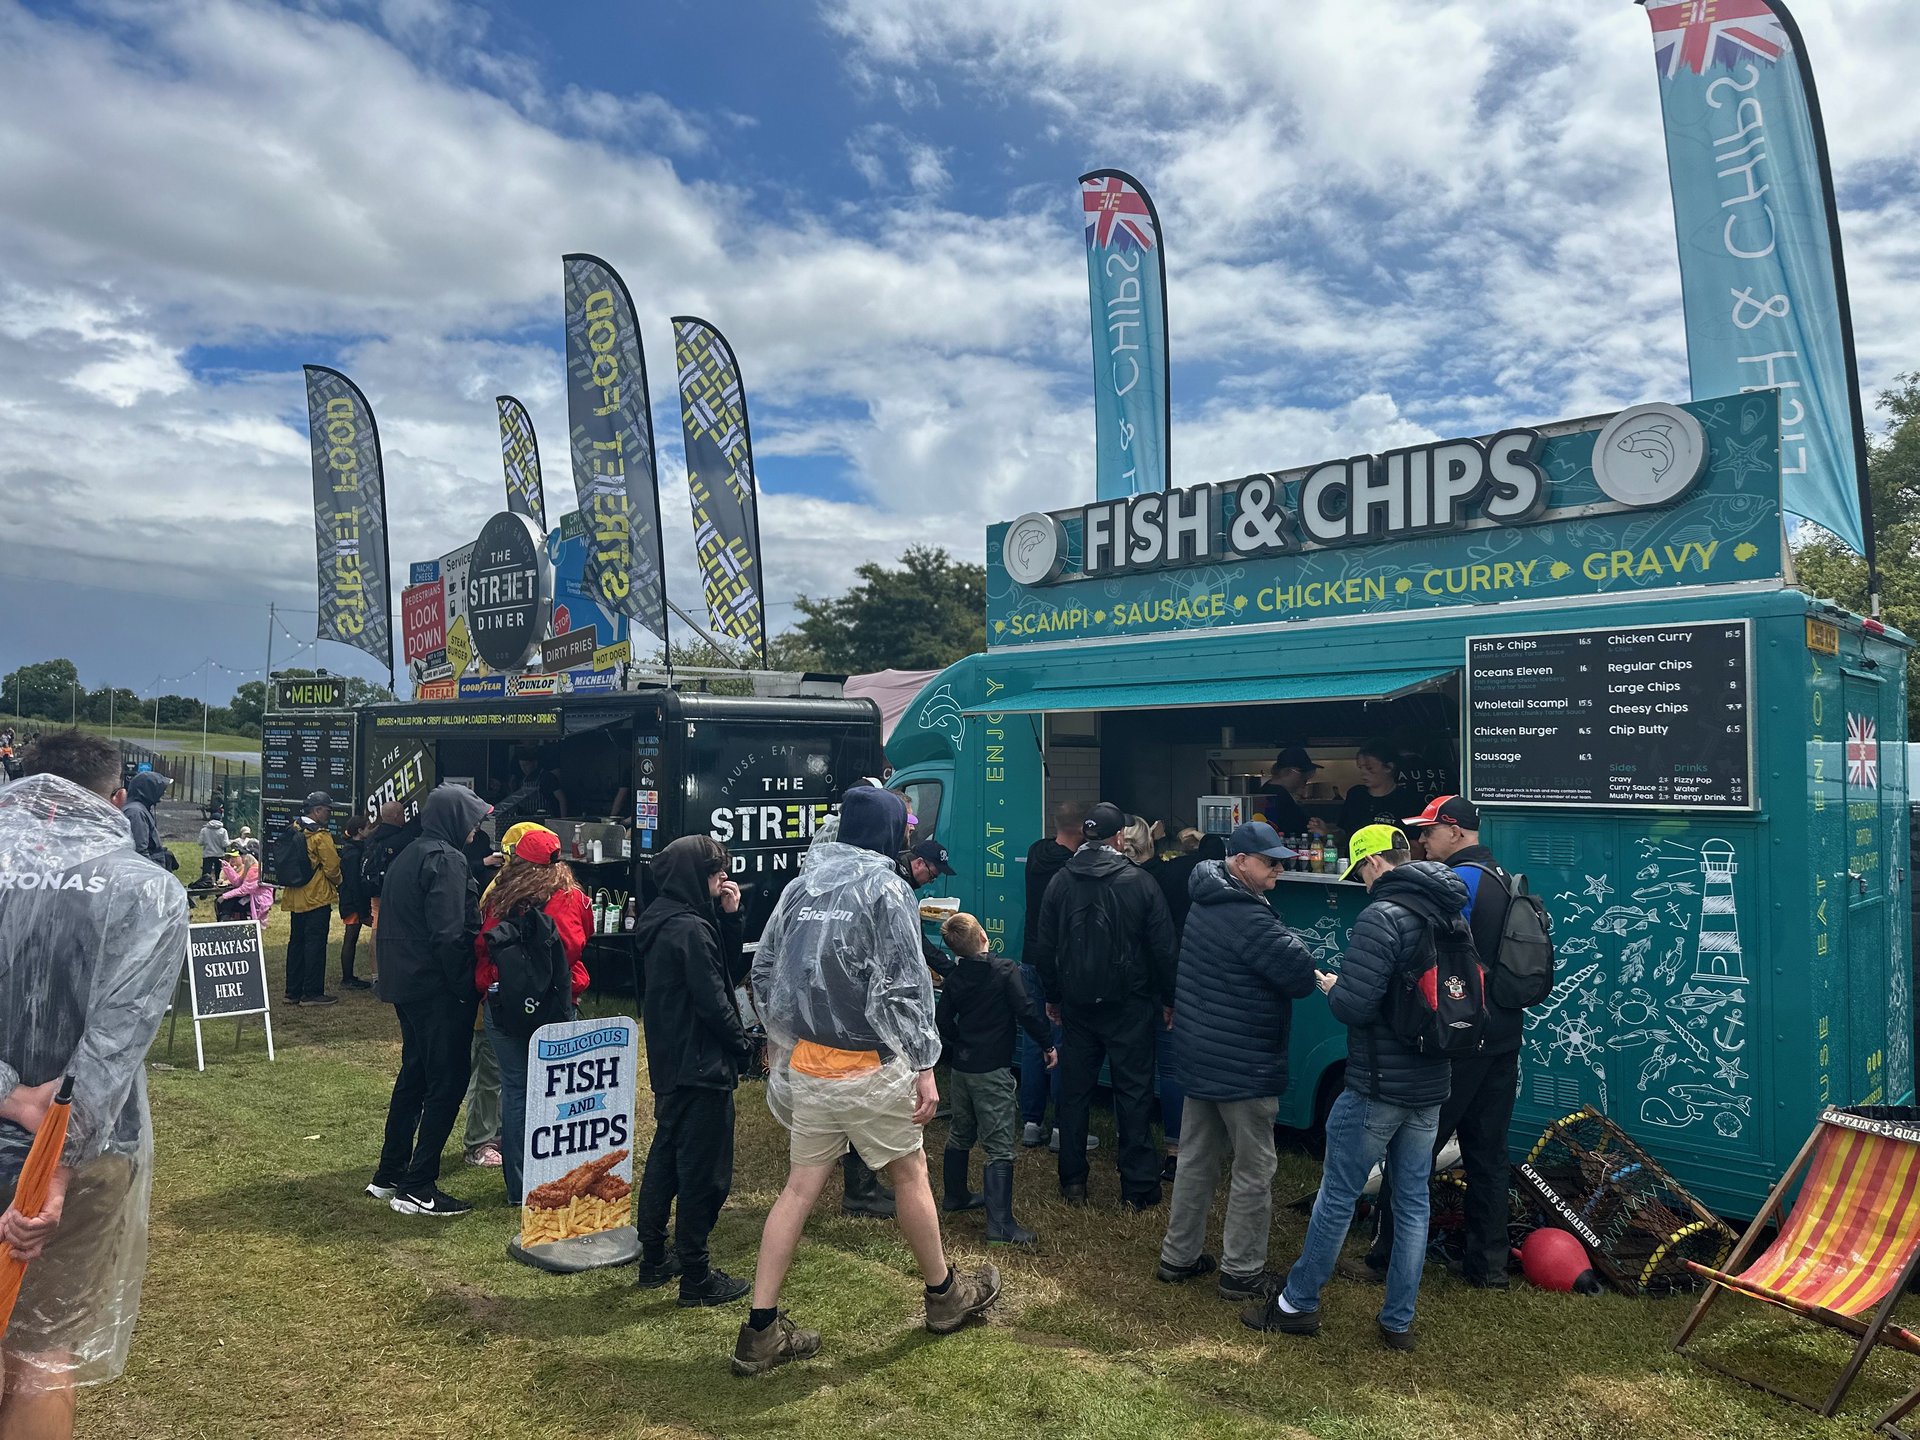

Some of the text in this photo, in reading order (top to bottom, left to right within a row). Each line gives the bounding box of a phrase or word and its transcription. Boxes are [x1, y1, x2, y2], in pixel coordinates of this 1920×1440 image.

[1085, 428, 1543, 575] FISH & CHIPS
[491, 549, 511, 564] THE
[416, 563, 434, 572] NACHO
[415, 572, 434, 582] CHEESE
[405, 583, 441, 608] PEDESTRIANS
[470, 569, 537, 608] STREET
[1011, 540, 1719, 635] SCAMPI SAUSAGE CHICKEN CURRY GRAVY
[410, 602, 439, 631] LOOK
[478, 612, 524, 631] DINER
[554, 614, 570, 632] STOP
[408, 626, 441, 655] DOWN
[450, 635, 467, 648] STEAK
[1473, 643, 1493, 652] Fish
[1507, 640, 1537, 651] Chips
[1607, 632, 1692, 645] Chicken Curry
[447, 645, 468, 661] BURGER
[546, 637, 593, 663] DIRTY FRIES
[596, 647, 627, 665] HOT DOGS
[1473, 666, 1553, 678] Oceans Eleven
[1608, 659, 1693, 674] Regular Chips
[461, 681, 501, 692] GOODYEAR
[519, 680, 555, 690] DUNLOP
[1608, 681, 1681, 694] Large Chips
[1729, 681, 1737, 689] 8
[291, 685, 333, 704] MENU
[1474, 698, 1568, 710] Wholetail Scampi
[1608, 703, 1689, 715] Cheesy Chips
[376, 717, 394, 726] BURGERS
[397, 716, 412, 726] PULLED
[412, 716, 424, 726] PORK
[468, 714, 488, 724] LOADED
[488, 714, 501, 724] FRIES
[505, 714, 517, 724] HOT
[517, 714, 533, 723] DOGS
[536, 713, 557, 723] DRINKS
[1474, 726, 1558, 737] Chicken Burger
[1608, 724, 1668, 736] Chip Butty
[1726, 725, 1740, 733] 6.5
[1811, 657, 1824, 812] ENJOY
[381, 745, 400, 769] THE
[1474, 752, 1522, 763] Sausage
[721, 745, 795, 795] PAUSE EAT
[1398, 769, 1446, 780] AUSE
[1609, 763, 1638, 772] Sides
[1674, 763, 1708, 772] Drinks
[367, 750, 423, 823] STREET
[762, 777, 804, 791] THE
[1417, 781, 1446, 792] EAT
[1609, 792, 1633, 800] Mushy
[709, 803, 841, 843] STREE
[986, 822, 1005, 878] EAT
[1816, 874, 1828, 956] EAT
[192, 938, 257, 958] BREAKFAST
[204, 960, 250, 979] SERVED
[215, 982, 244, 999] HERE
[546, 1029, 622, 1057] DELICIOUS
[545, 1056, 620, 1098] FISH
[567, 1096, 596, 1117] AND
[1822, 1110, 1881, 1132] CAPTAIN'S
[531, 1113, 627, 1160] CHIPS
[1520, 1163, 1601, 1248] CAPTAIN'S QUARTERS
